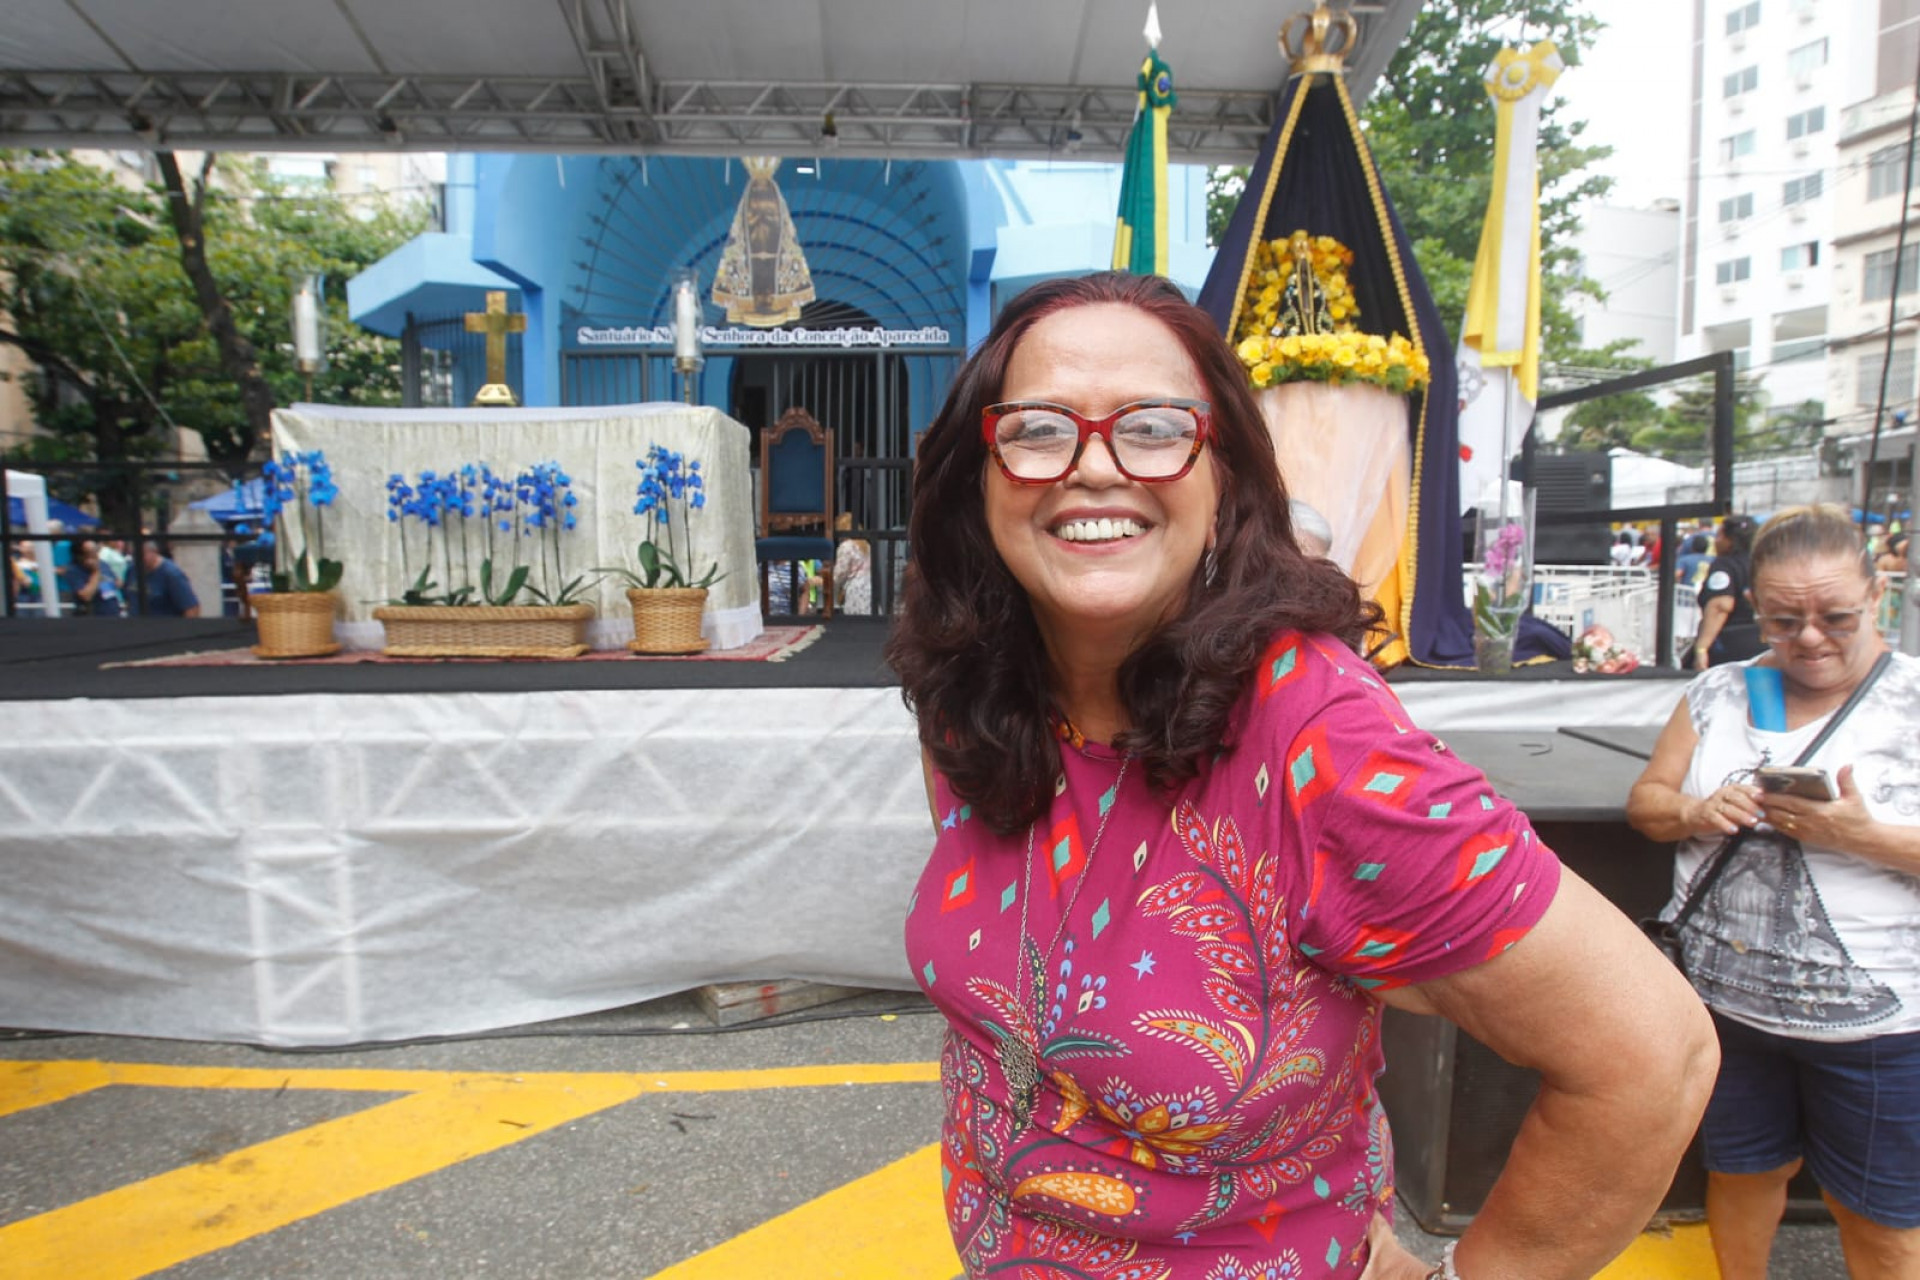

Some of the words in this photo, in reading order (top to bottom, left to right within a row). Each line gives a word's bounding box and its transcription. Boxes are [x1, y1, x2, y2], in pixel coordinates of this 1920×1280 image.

[702, 327, 767, 343] Senhora
[771, 327, 790, 343] da
[794, 327, 869, 346] Conceição
[873, 327, 949, 346] Aparecida
